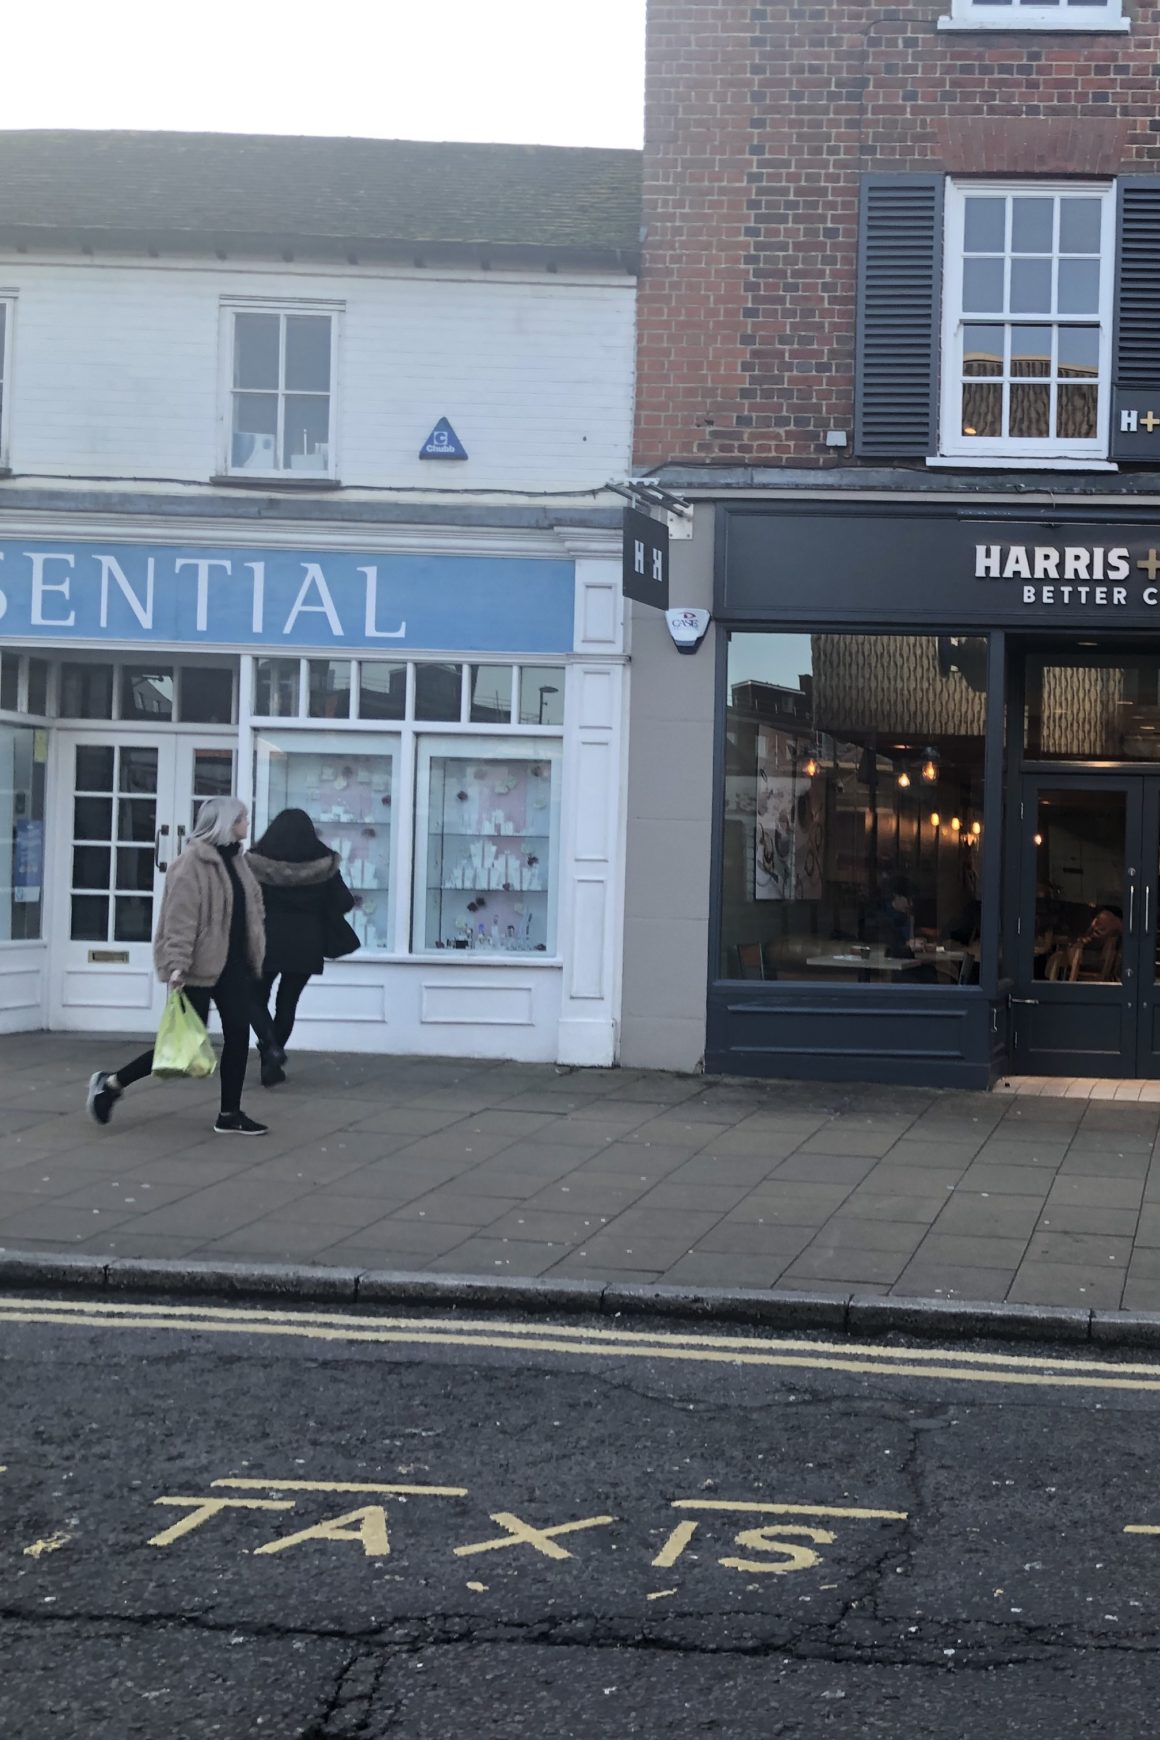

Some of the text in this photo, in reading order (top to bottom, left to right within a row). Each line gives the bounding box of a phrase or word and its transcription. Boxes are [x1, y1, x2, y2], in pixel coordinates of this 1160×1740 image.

[426, 444, 456, 453] Chubb
[975, 545, 1131, 581] HARRIS
[0, 551, 407, 639] ENTIAL
[1023, 585, 1128, 606] BETTER
[147, 1498, 837, 1573] TAXIS
